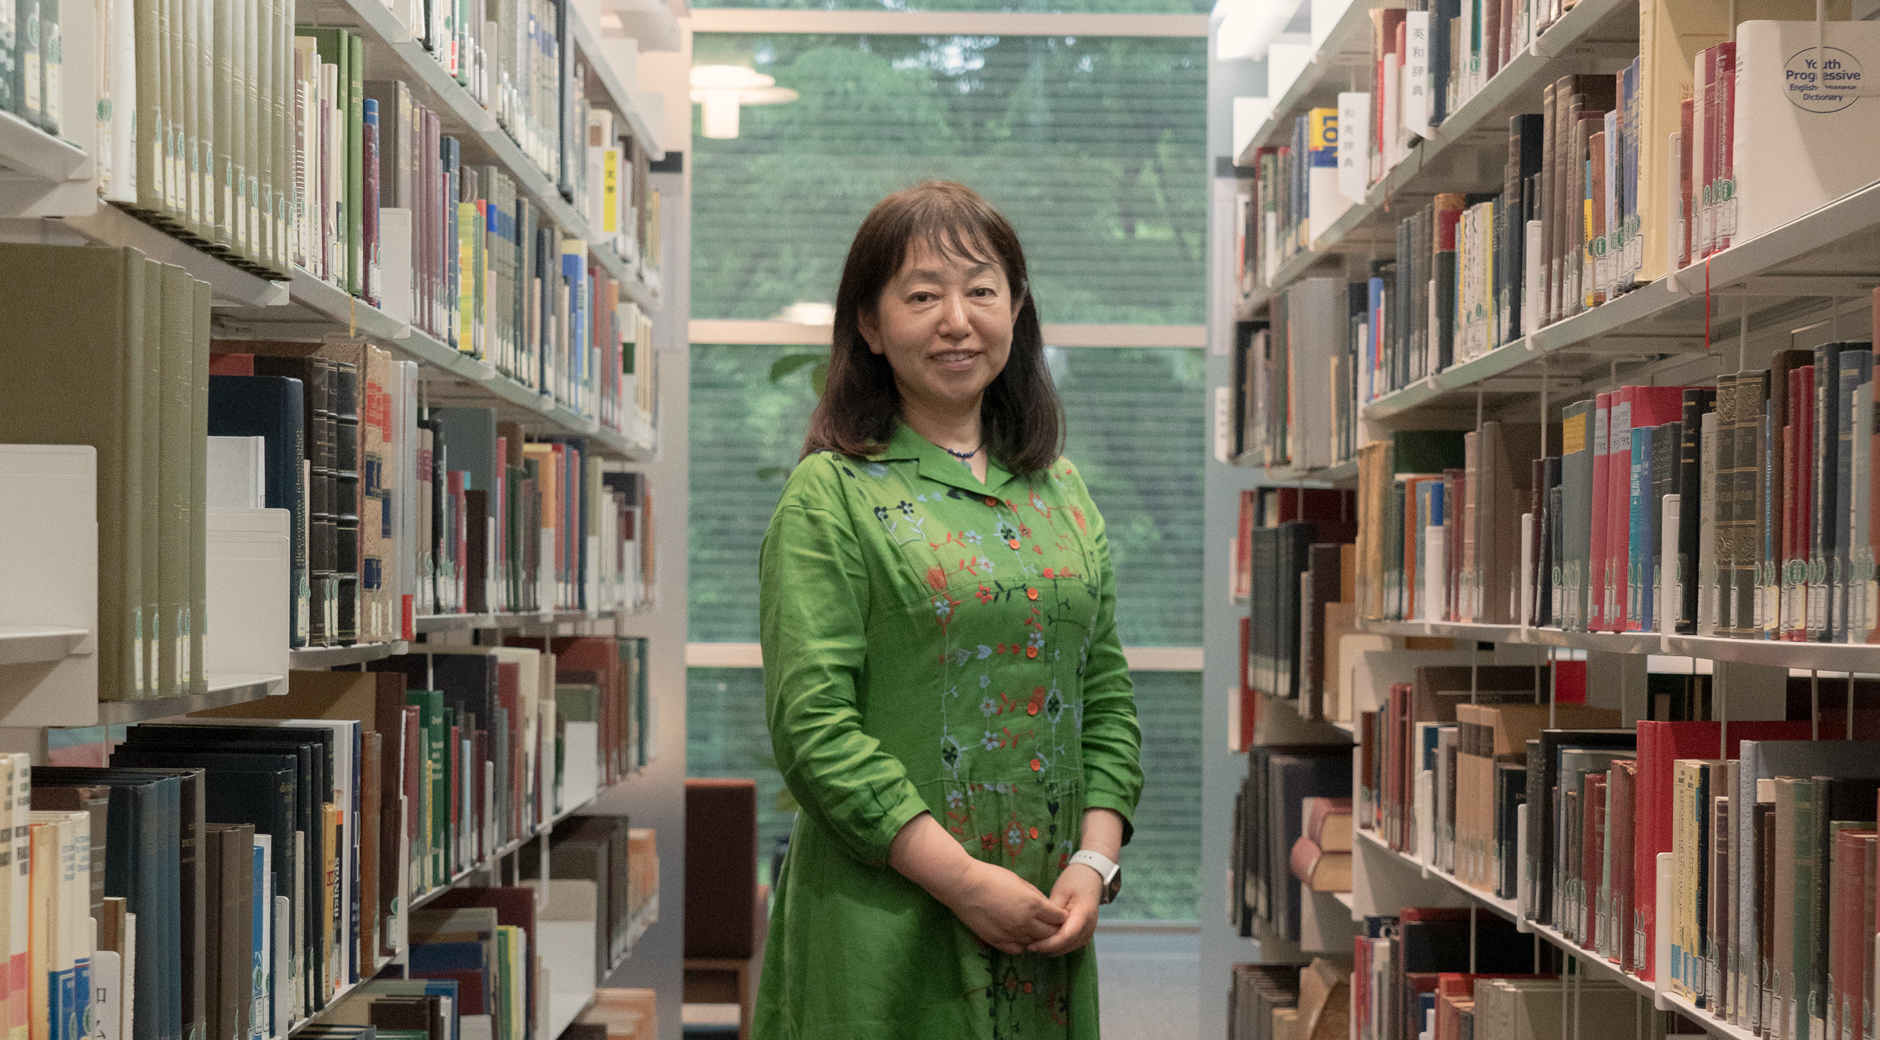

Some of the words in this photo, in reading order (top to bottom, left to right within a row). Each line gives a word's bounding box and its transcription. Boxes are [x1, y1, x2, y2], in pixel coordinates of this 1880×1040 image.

[1411, 27, 1425, 97] 英和辞典
[1803, 93, 1843, 102] Dictionary
